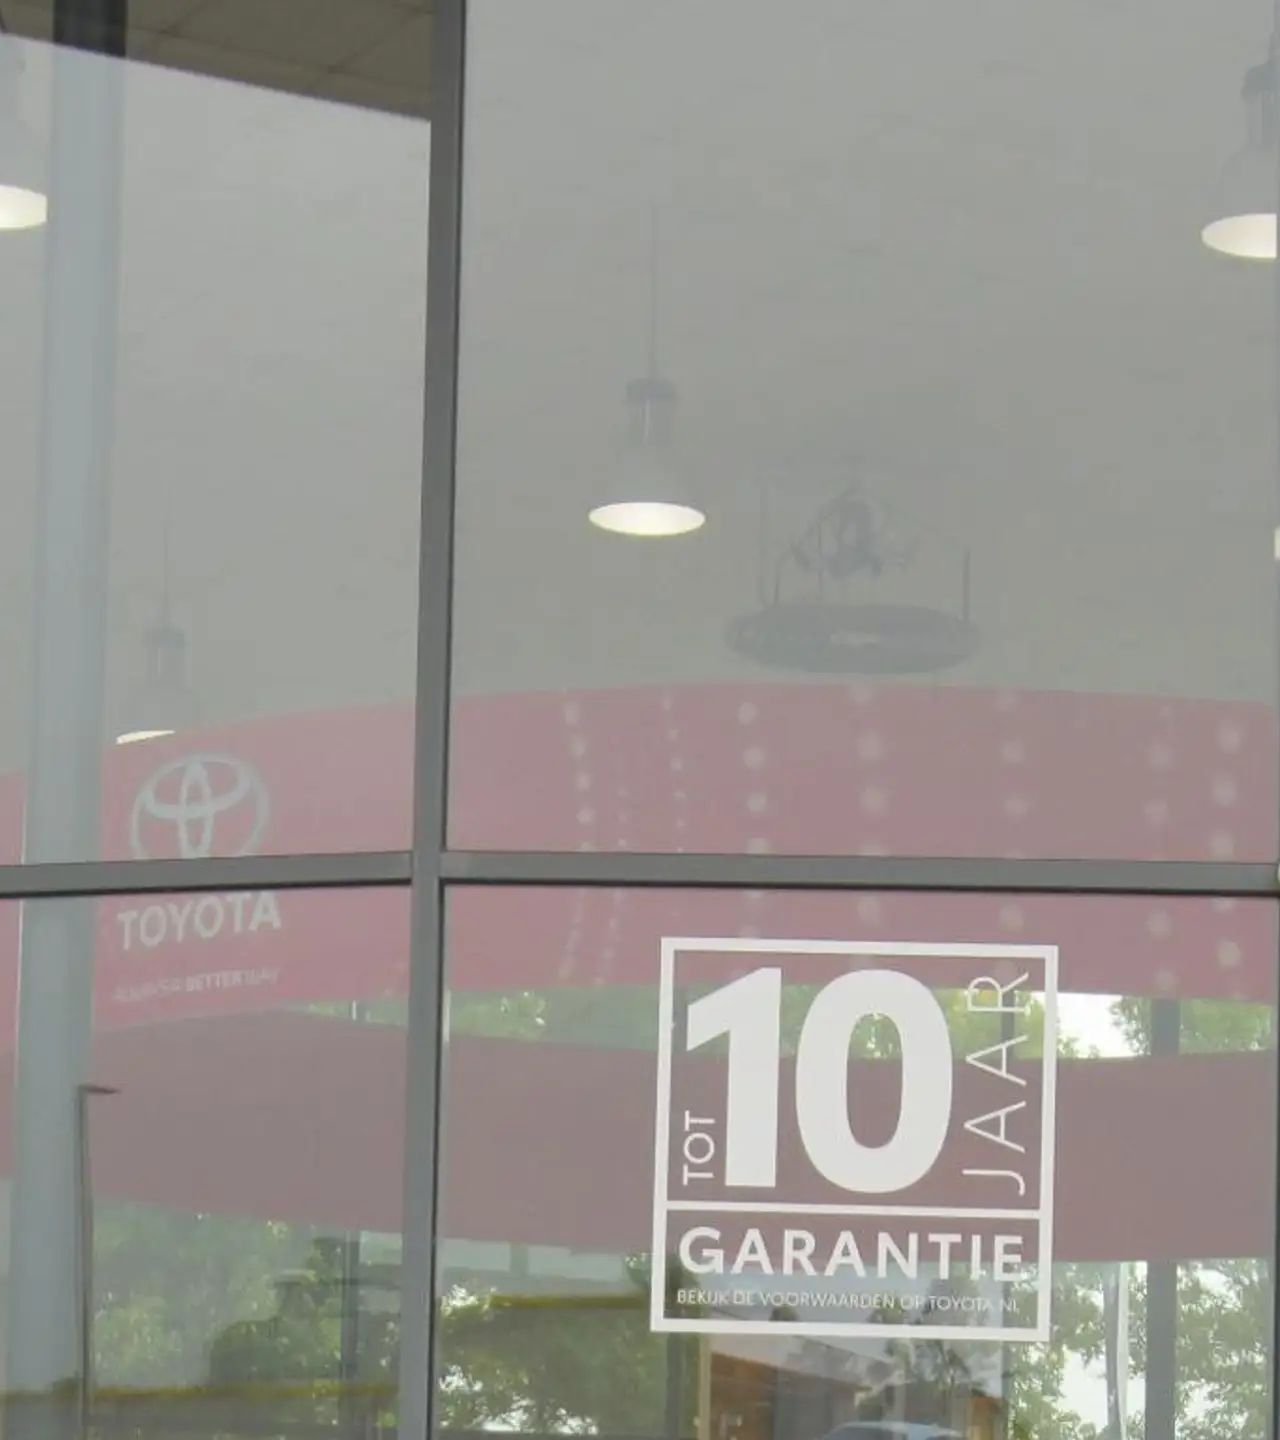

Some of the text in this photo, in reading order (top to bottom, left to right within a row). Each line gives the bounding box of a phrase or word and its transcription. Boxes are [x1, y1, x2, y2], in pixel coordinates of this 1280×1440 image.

[117, 892, 282, 951] TOYOTA
[686, 967, 953, 1194] 10
[963, 971, 1030, 1197] JAAR
[683, 1110, 715, 1186] TOT
[678, 1226, 1024, 1283] GARANTIE
[759, 1291, 895, 1310] VOORWAARDEN
